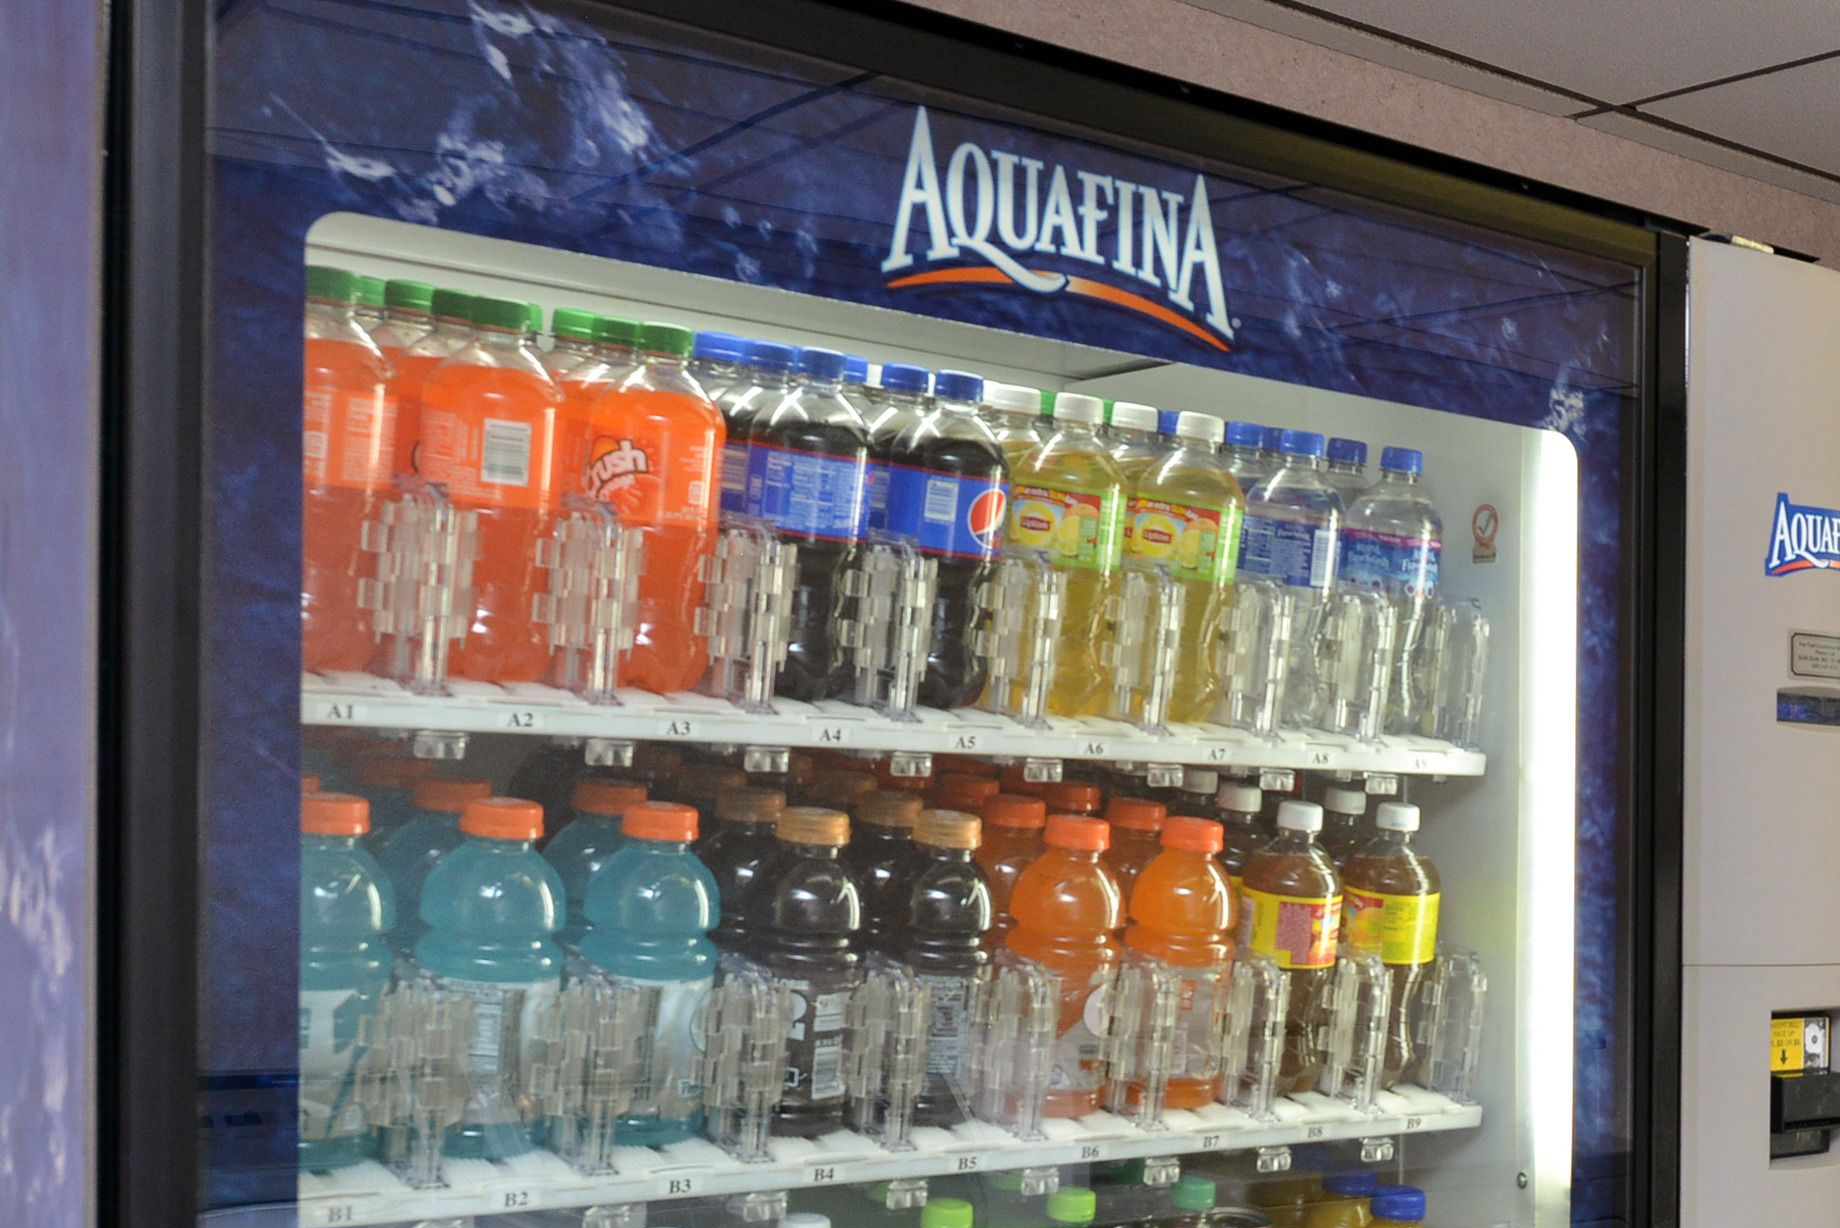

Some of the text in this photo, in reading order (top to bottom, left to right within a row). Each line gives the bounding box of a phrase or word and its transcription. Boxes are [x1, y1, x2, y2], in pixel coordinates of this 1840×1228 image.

[881, 105, 1235, 341] AQUAFINA
[328, 705, 354, 720] A1
[507, 713, 534, 727] A2
[666, 721, 691, 735] A3
[819, 728, 842, 742] A4
[955, 736, 976, 750] A5
[1084, 743, 1104, 756] A6
[1208, 749, 1226, 761] A7
[1312, 753, 1329, 765] A8
[1406, 1117, 1422, 1129] B9
[1307, 1126, 1323, 1138] B8
[1203, 1135, 1220, 1148] B7
[1081, 1145, 1100, 1158] B6
[958, 1156, 978, 1170] B5
[813, 1168, 835, 1182] B4
[669, 1178, 693, 1193] B3
[504, 1192, 529, 1207] B2
[328, 1205, 354, 1222] B1
